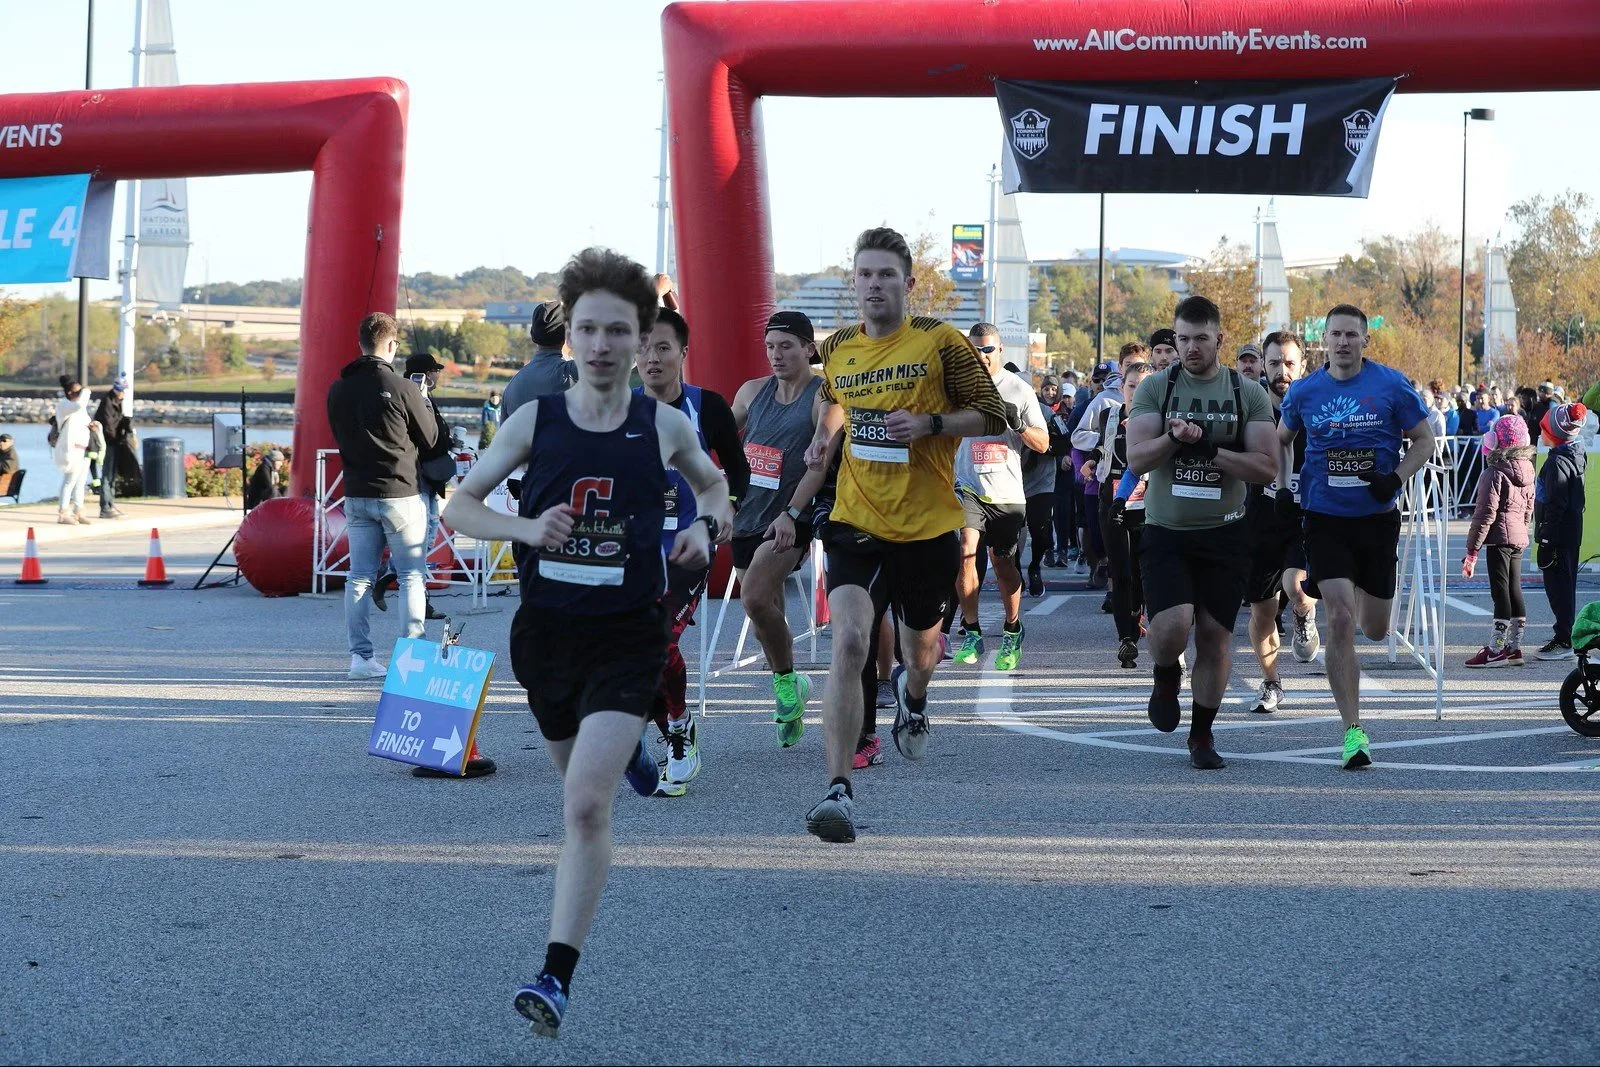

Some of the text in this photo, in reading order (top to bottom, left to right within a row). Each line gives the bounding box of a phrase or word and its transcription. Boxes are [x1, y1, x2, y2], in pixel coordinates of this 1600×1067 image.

[1033, 28, 1367, 54] www.AllCommunityEvents.com
[1084, 103, 1307, 156] FINISH
[48, 205, 78, 248] 4
[834, 363, 928, 390] SOUTHERN MISS
[843, 381, 915, 400] TRACK & FIELD
[1206, 413, 1238, 421] GYM
[1342, 419, 1384, 429] Independence
[1365, 412, 1378, 420] for
[1175, 468, 1204, 482] 5461
[1328, 460, 1359, 471] 6543
[465, 650, 487, 673] TO
[425, 676, 475, 703] MILE 4
[400, 709, 422, 732] TO
[375, 730, 425, 758] FINISH
